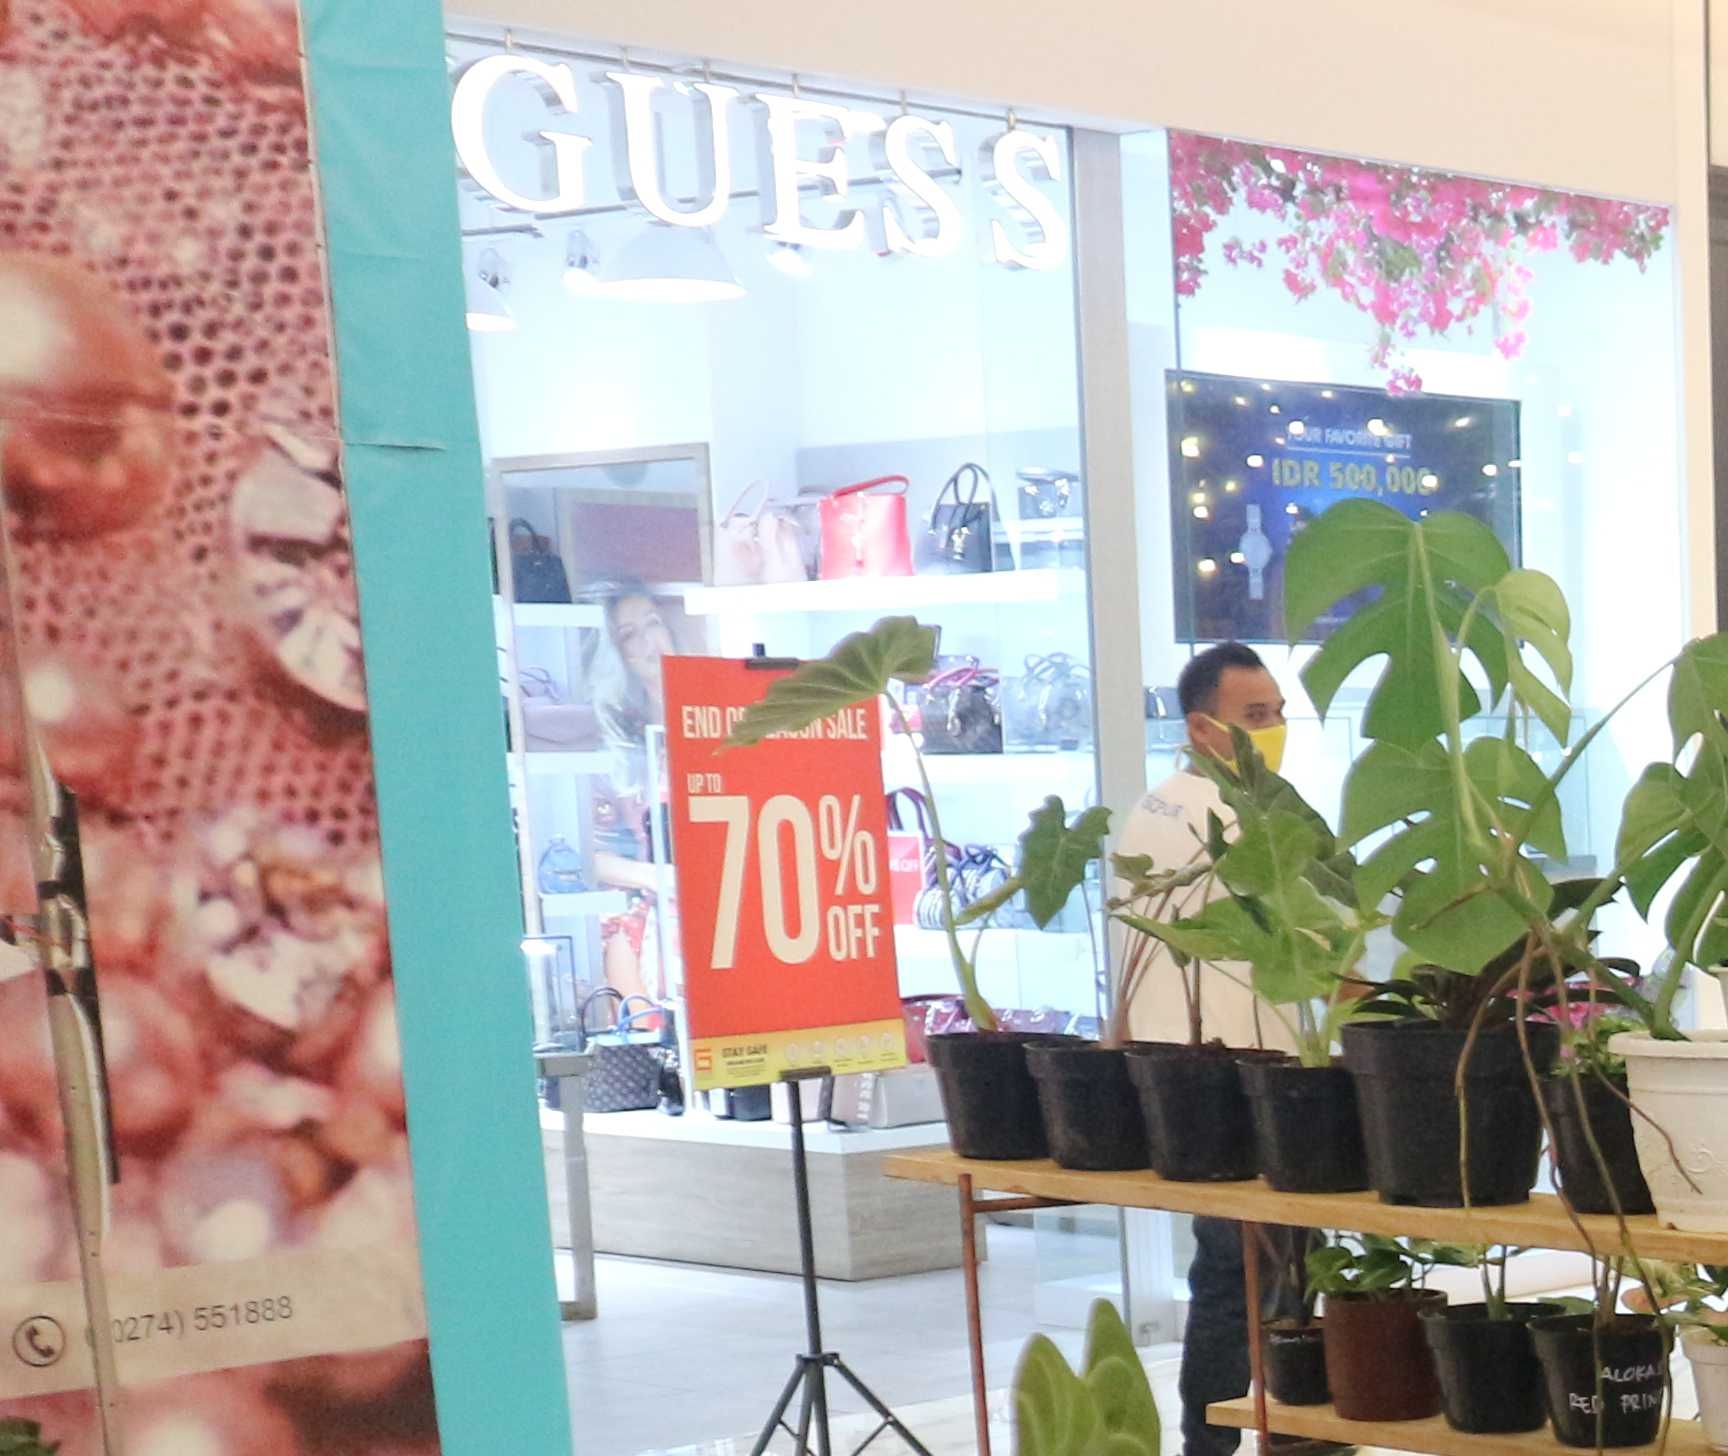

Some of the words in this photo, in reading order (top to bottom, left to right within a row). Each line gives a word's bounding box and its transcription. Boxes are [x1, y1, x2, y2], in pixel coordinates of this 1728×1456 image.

[451, 54, 1067, 271] GUESS
[1271, 457, 1321, 487] IDR
[1329, 461, 1437, 497] 500,000
[682, 705, 721, 739] END
[826, 708, 868, 740] SALE
[687, 773, 704, 793] UP
[706, 773, 722, 793] TO
[688, 794, 877, 969] 70%
[826, 904, 881, 962] OFF
[111, 1309, 186, 1344] 0274)
[194, 1295, 293, 1332] 551888
[1600, 1364, 1661, 1383] ALOKA
[1620, 1393, 1659, 1415] PRIN
